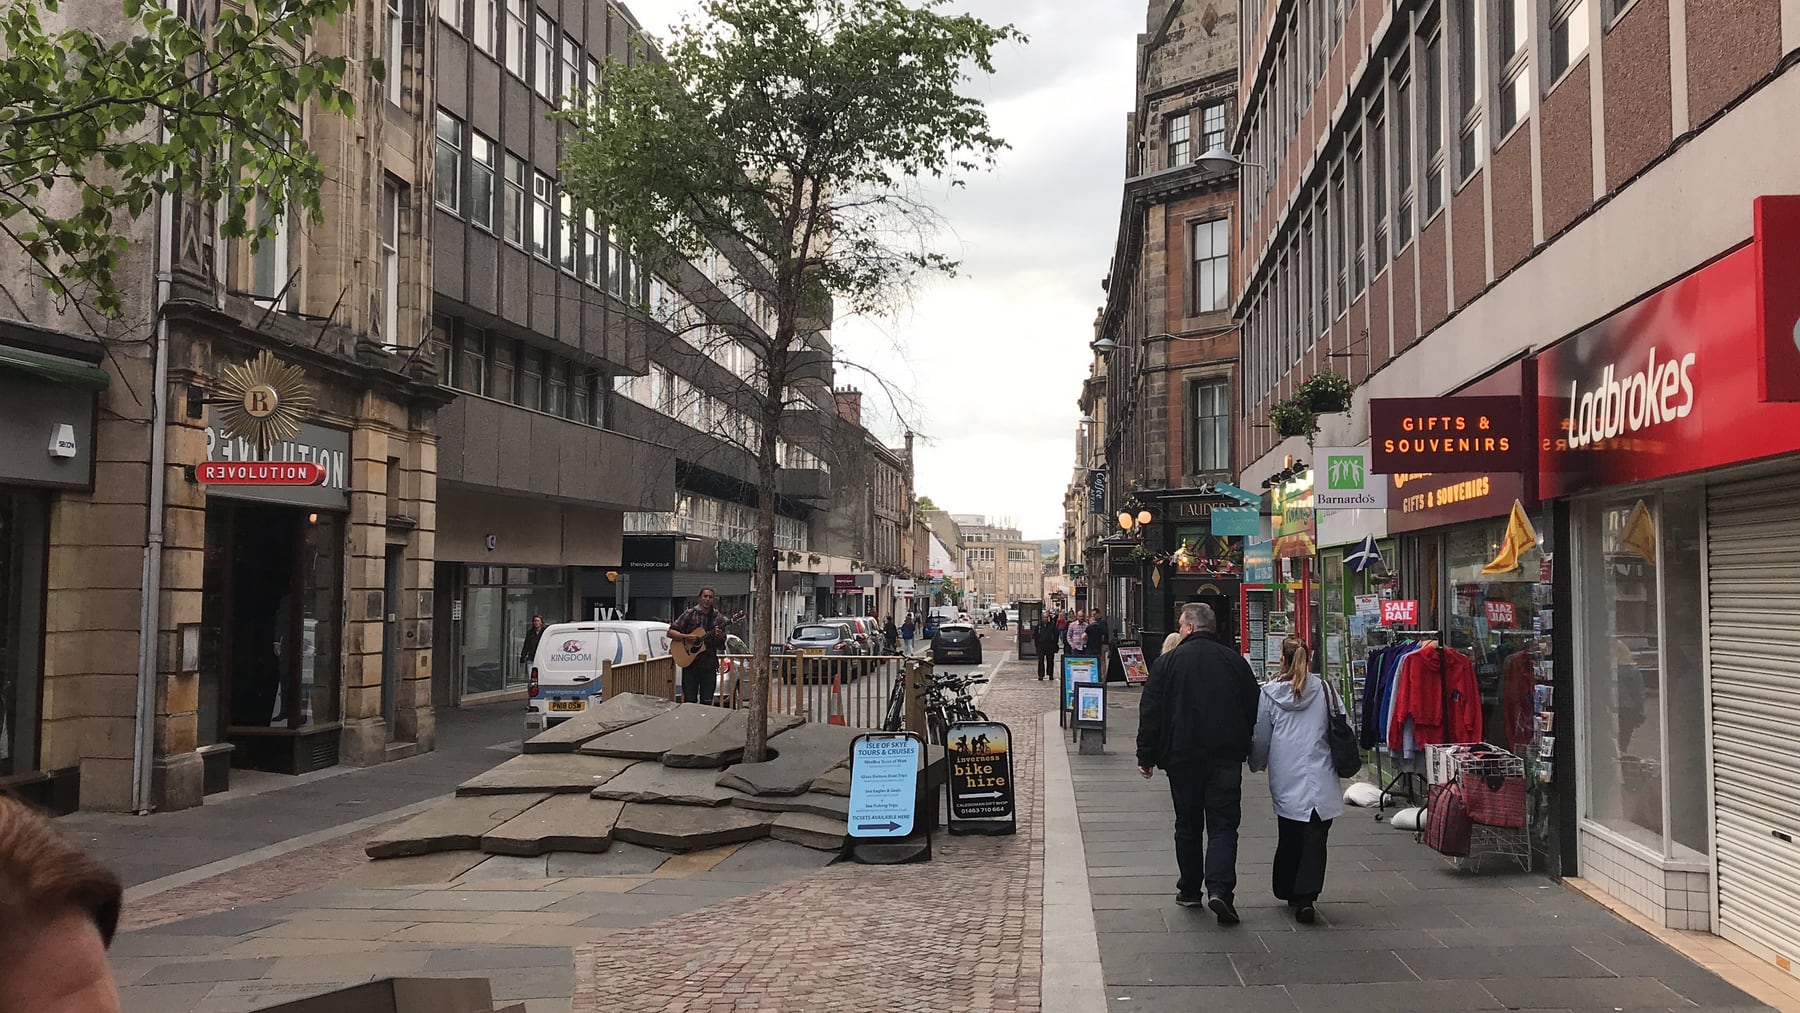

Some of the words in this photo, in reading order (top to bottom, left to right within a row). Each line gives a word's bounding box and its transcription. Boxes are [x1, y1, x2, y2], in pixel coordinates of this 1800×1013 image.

[250, 391, 270, 412] R
[1568, 346, 1696, 449] Ladbrokes
[1403, 417, 1466, 431] GIFTS
[1479, 416, 1490, 430] &
[1384, 437, 1510, 453] SOUVENIRS
[206, 467, 307, 479] REVOLUTION
[1094, 472, 1105, 499] Coffee
[1317, 493, 1376, 504] Barnardo's
[1402, 493, 1425, 513] GIFTS
[1427, 491, 1434, 508] &
[1436, 476, 1489, 506] SOUVENIRS
[1384, 601, 1414, 611] SALE
[1385, 611, 1412, 621] RAIL
[550, 653, 592, 662] KINGDOM
[954, 763, 993, 776] bike
[966, 775, 1005, 788] hire
